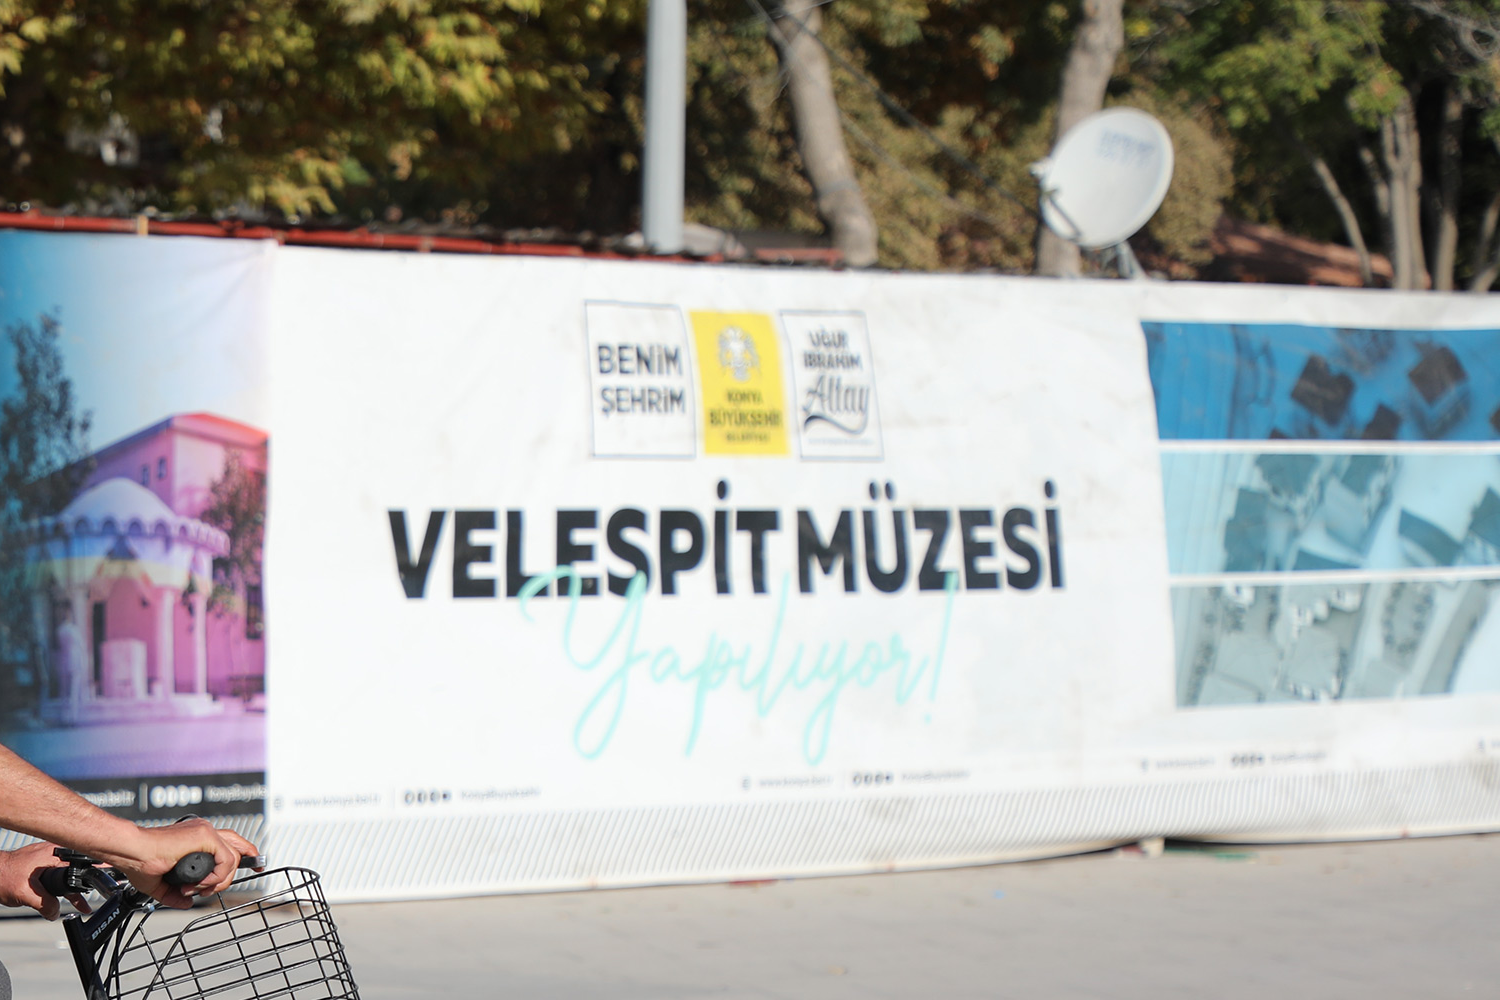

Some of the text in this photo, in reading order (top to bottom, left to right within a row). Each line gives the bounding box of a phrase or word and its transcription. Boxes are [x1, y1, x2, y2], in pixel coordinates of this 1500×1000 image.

[598, 345, 683, 376] BENİM
[601, 387, 686, 419] ŞEHRİM
[387, 479, 1066, 601] VELESPİT MÜZESİ
